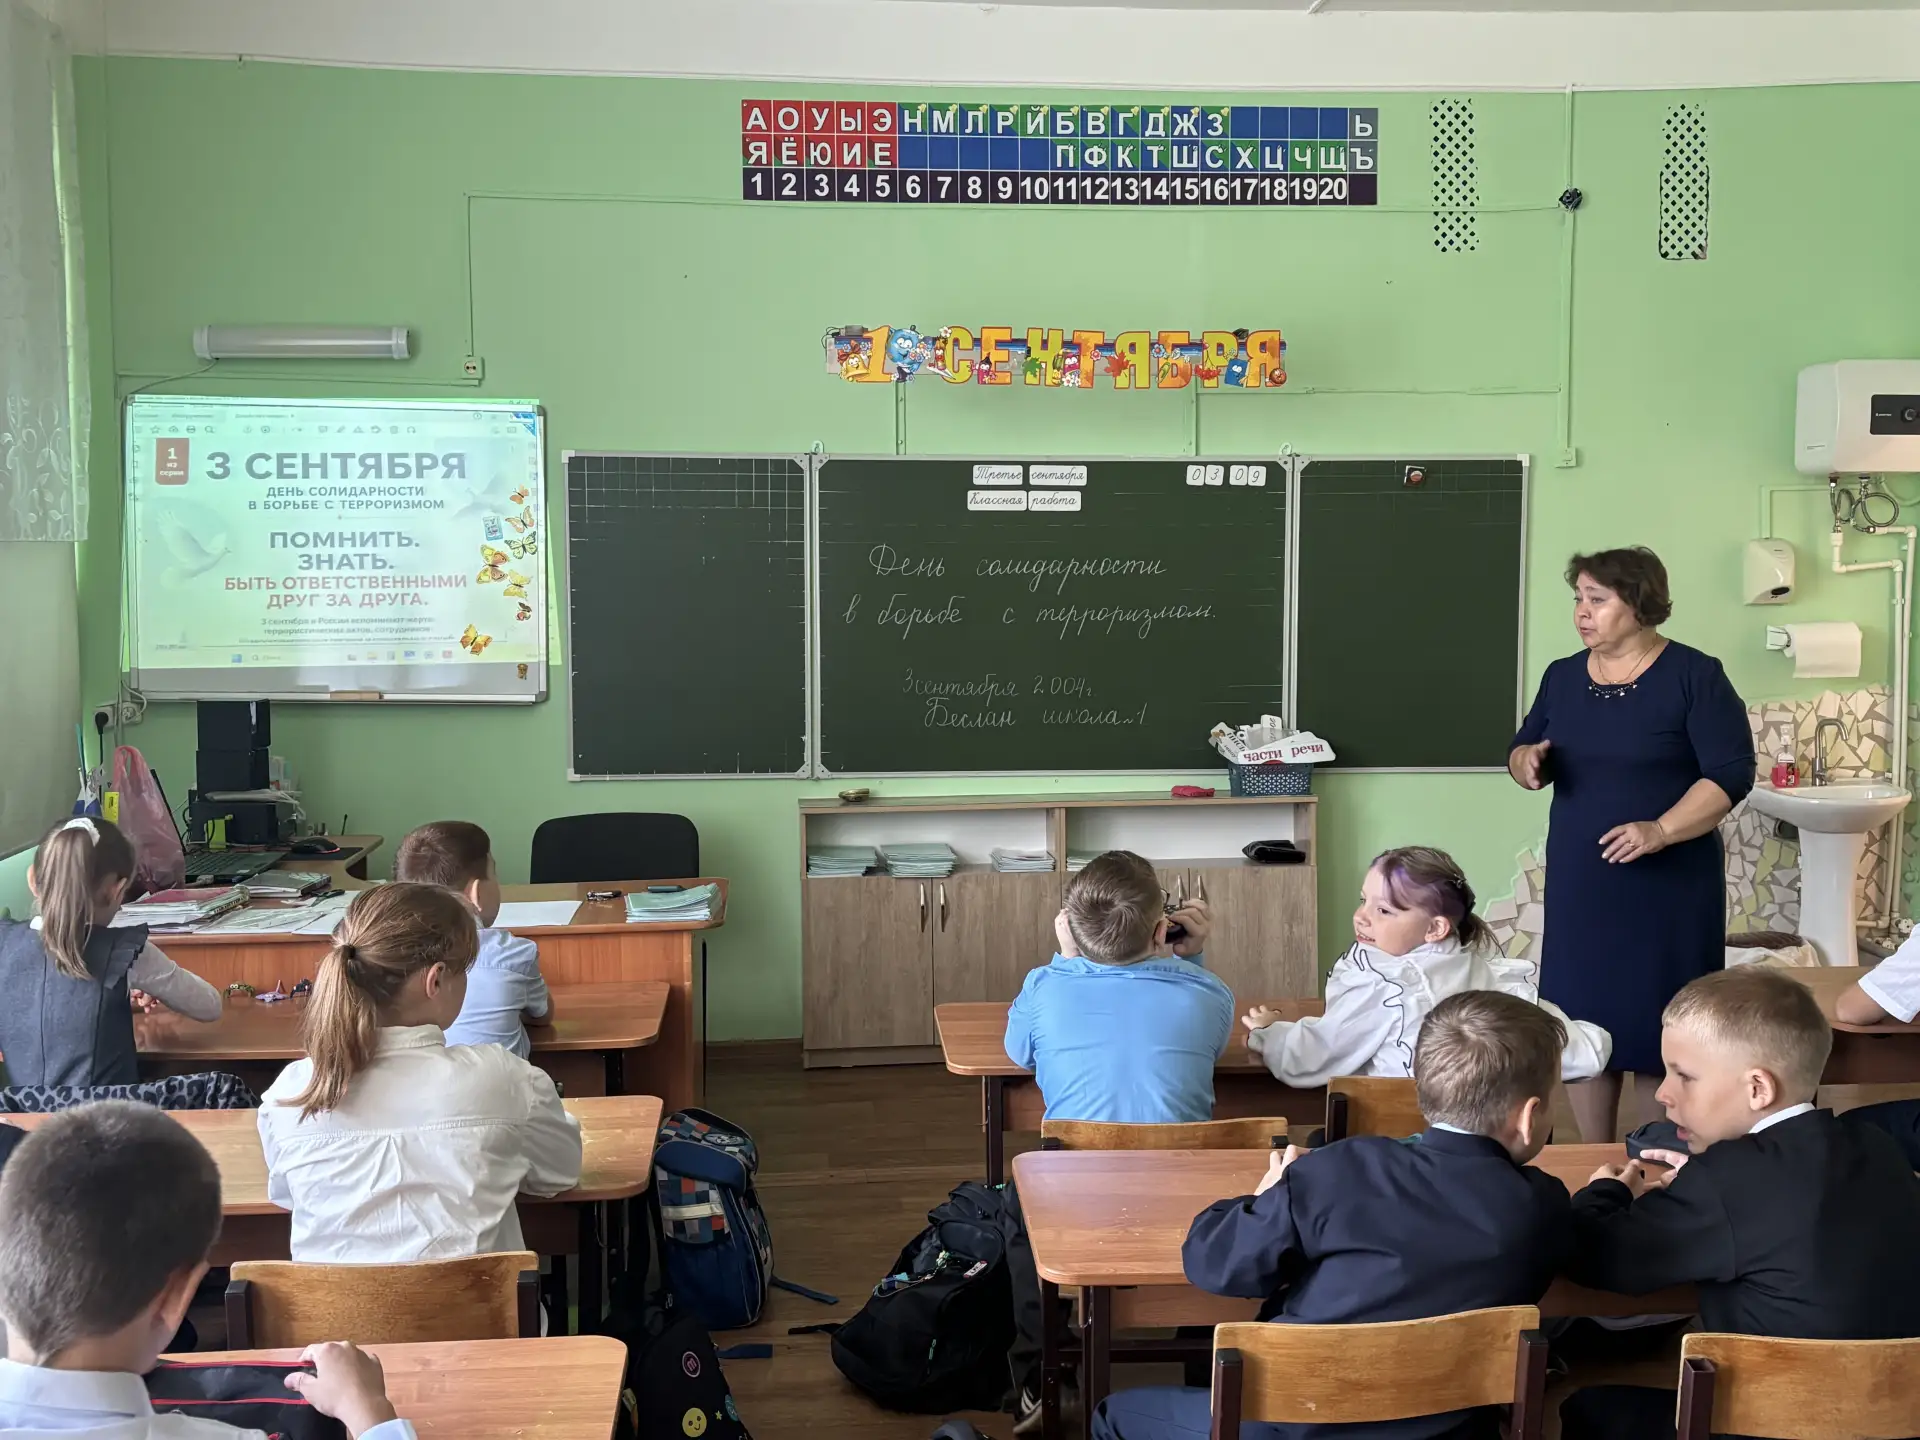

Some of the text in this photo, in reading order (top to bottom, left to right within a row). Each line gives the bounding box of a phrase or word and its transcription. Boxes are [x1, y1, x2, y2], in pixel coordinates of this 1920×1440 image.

[745, 105, 1373, 137] А О У Ы Э Н М Л Р Й Б В Г Д Ж З Ь
[747, 137, 1373, 172] Я Ё Ю И Е П Ф К Т Ш С Х Ц Ч Щ Ъ
[751, 173, 1347, 200] 1 2 3 4 5 6 7 8 9 10 11 12 13 14 15 16 17 18 19 20
[855, 325, 1284, 389] 1 СЕНТЯБРЯ
[167, 447, 178, 459] 1
[206, 452, 466, 479] 3 СЕНТЯБРЯ
[974, 466, 1022, 484] Третье
[1031, 468, 1085, 483] сентября
[266, 486, 424, 497] ДЕНЬ СОЛИДАРНОСТИ
[969, 491, 1077, 508] Классная работа
[249, 500, 444, 510] В БОРЬБЕ С ТЕРРОРИЗМОМ
[270, 531, 420, 549] ПОМНИТЬ.
[298, 553, 395, 571] ЗНАТЬ.
[868, 543, 1168, 595] День солидарности
[224, 575, 467, 591] БЫТЬ ОТВЕТСТВЕННЫМИ
[267, 592, 429, 609] ДРУГ ЗА ДРУГА.
[842, 593, 861, 625] в
[877, 593, 966, 640] борьбе
[1002, 607, 1016, 624] с
[1243, 749, 1283, 762] части
[1291, 744, 1324, 757] речи
